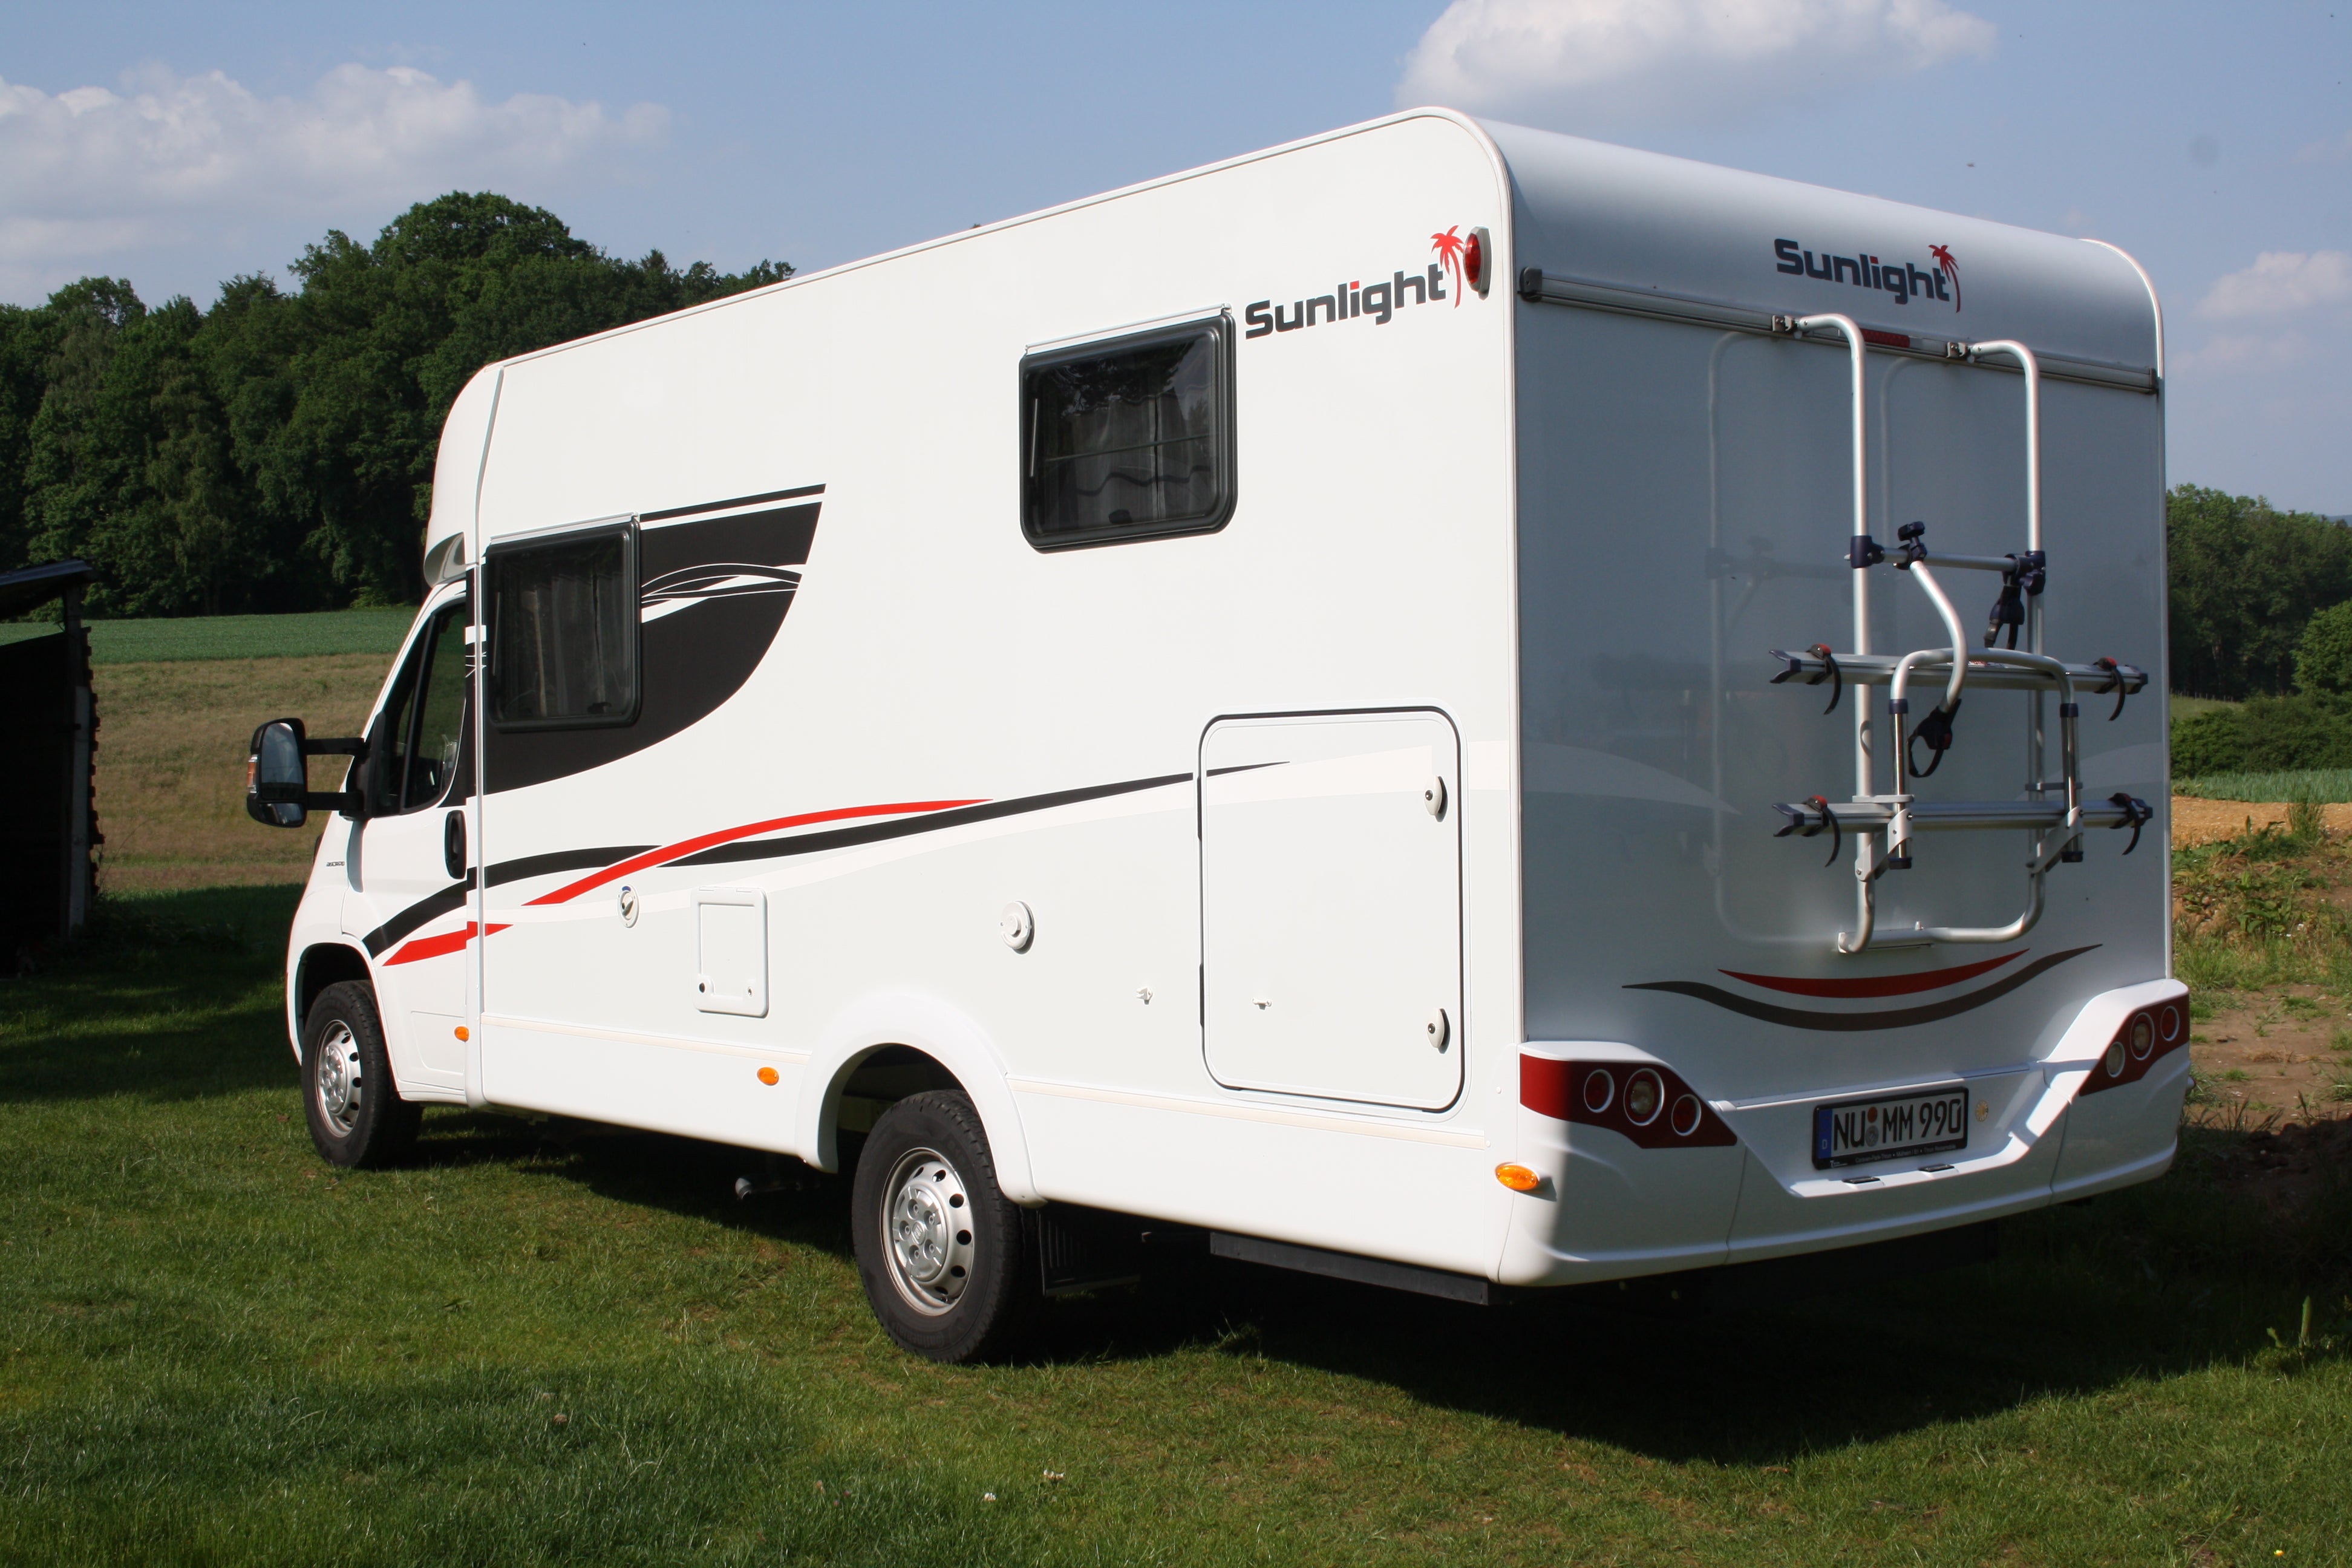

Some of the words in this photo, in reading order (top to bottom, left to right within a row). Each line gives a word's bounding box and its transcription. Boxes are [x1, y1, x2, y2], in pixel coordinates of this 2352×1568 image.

[1774, 238, 1950, 304] Sunlight
[1245, 263, 1446, 339] Sunlight
[1821, 1138, 1828, 1149] D
[1834, 1110, 1866, 1151] NU
[1882, 1104, 1913, 1143] MM
[1919, 1098, 1962, 1138] 990
